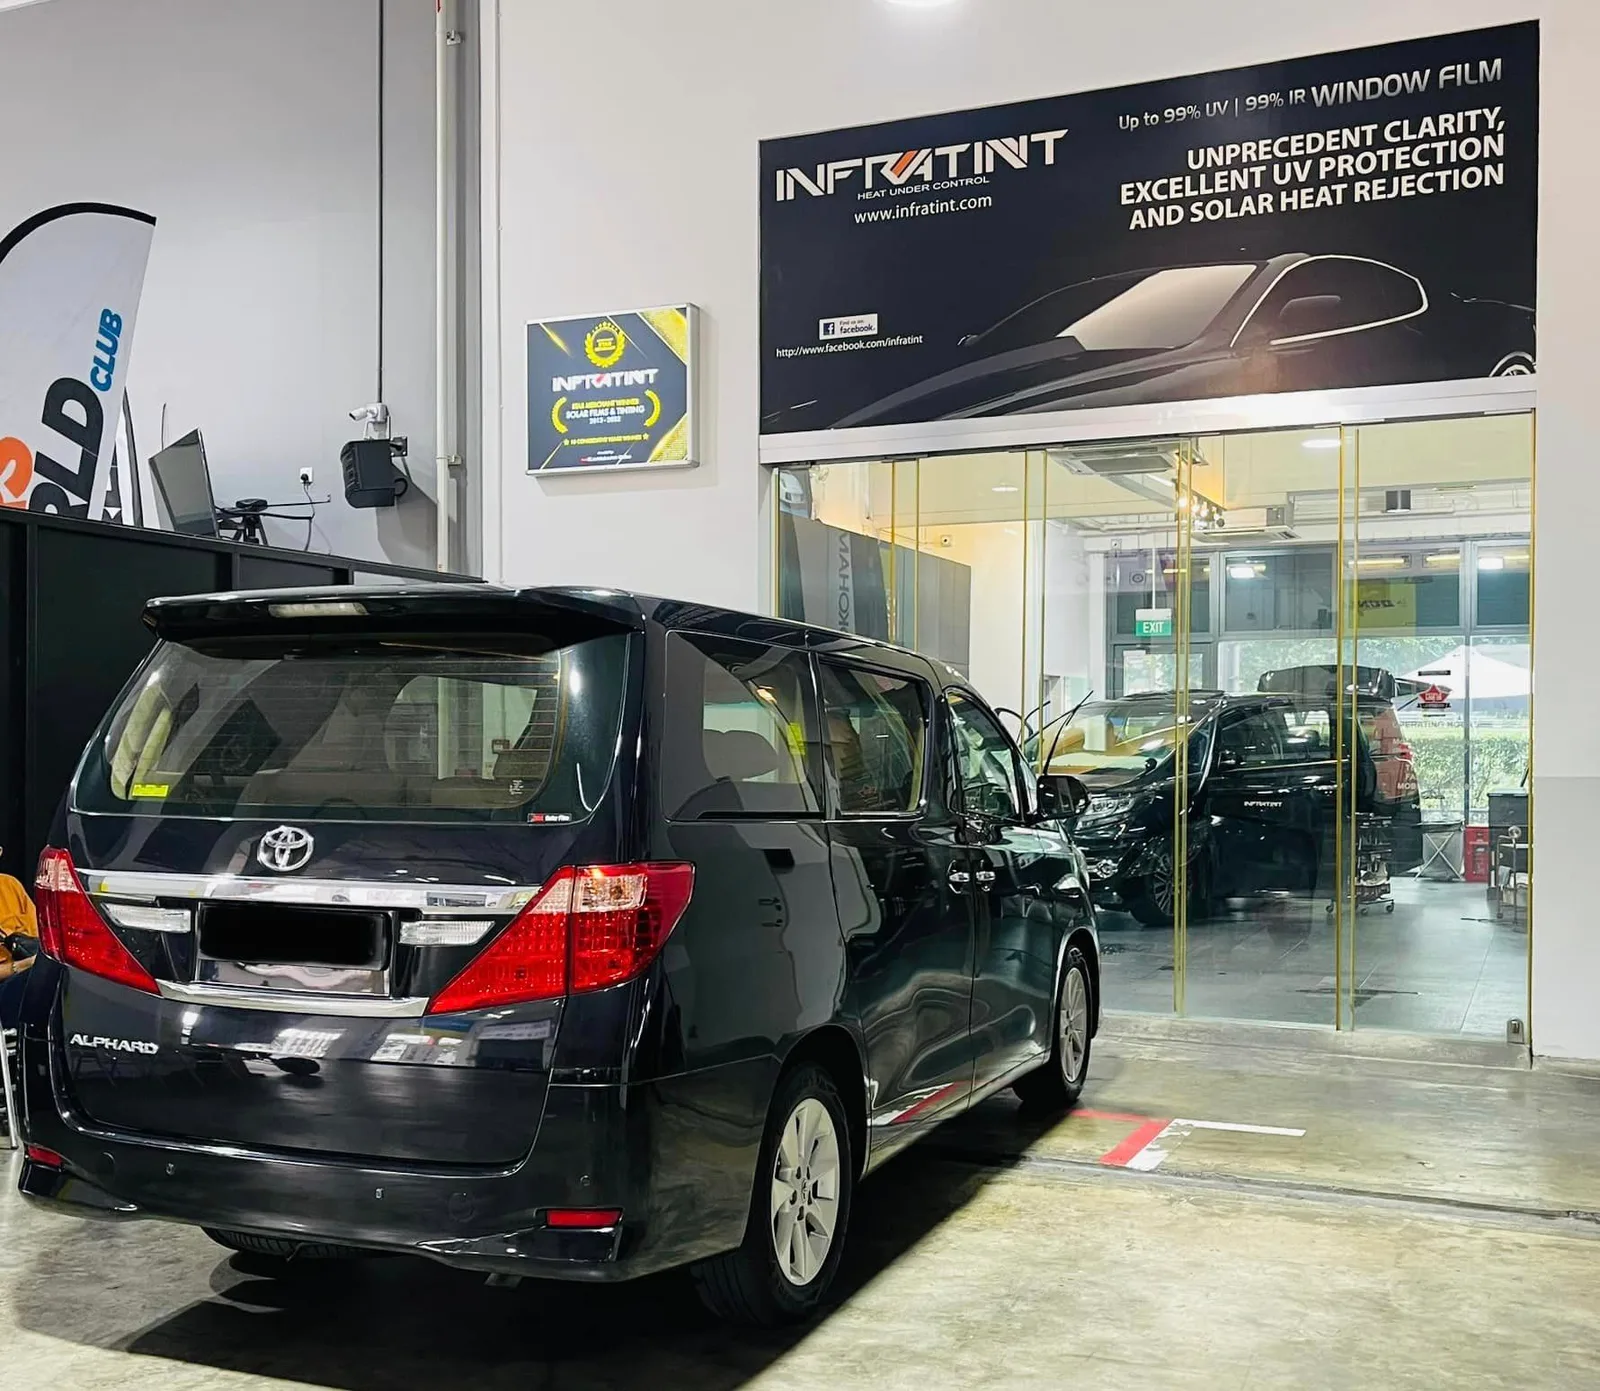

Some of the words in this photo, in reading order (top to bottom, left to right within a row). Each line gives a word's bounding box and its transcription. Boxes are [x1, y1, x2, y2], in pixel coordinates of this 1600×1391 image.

[1118, 114, 1140, 132] Up
[1143, 111, 1160, 126] to
[1163, 105, 1201, 123] 99%
[1205, 100, 1229, 117] UV
[1245, 92, 1284, 111] 99%
[1288, 88, 1306, 105] IR
[1310, 68, 1431, 108] WINDOW
[1438, 58, 1502, 90] FILM
[1187, 124, 1378, 170] UNPRECEDENT
[1383, 106, 1505, 143] CLARITY,
[776, 129, 1069, 201] INFRATINT
[857, 189, 887, 200] HEAT
[889, 184, 930, 196] UNDER
[932, 176, 991, 190] CONTROL
[1120, 165, 1267, 205] EXCELLENT
[1273, 159, 1313, 186] UV
[1318, 133, 1504, 180] PROTECTION
[854, 196, 992, 224] www.infratint.com
[1129, 204, 1184, 230] AND
[1190, 193, 1274, 223] SOLAR
[1280, 183, 1348, 212] HEAT
[1354, 163, 1504, 203] REJECTION
[90, 308, 122, 392] CLUB
[776, 335, 923, 358] http://www.facebook.com/infratint
[565, 409, 589, 420] SOLAR
[589, 407, 609, 418] FILMS
[1142, 621, 1165, 634] EXIT
[69, 1033, 159, 1055] ALPHARD
